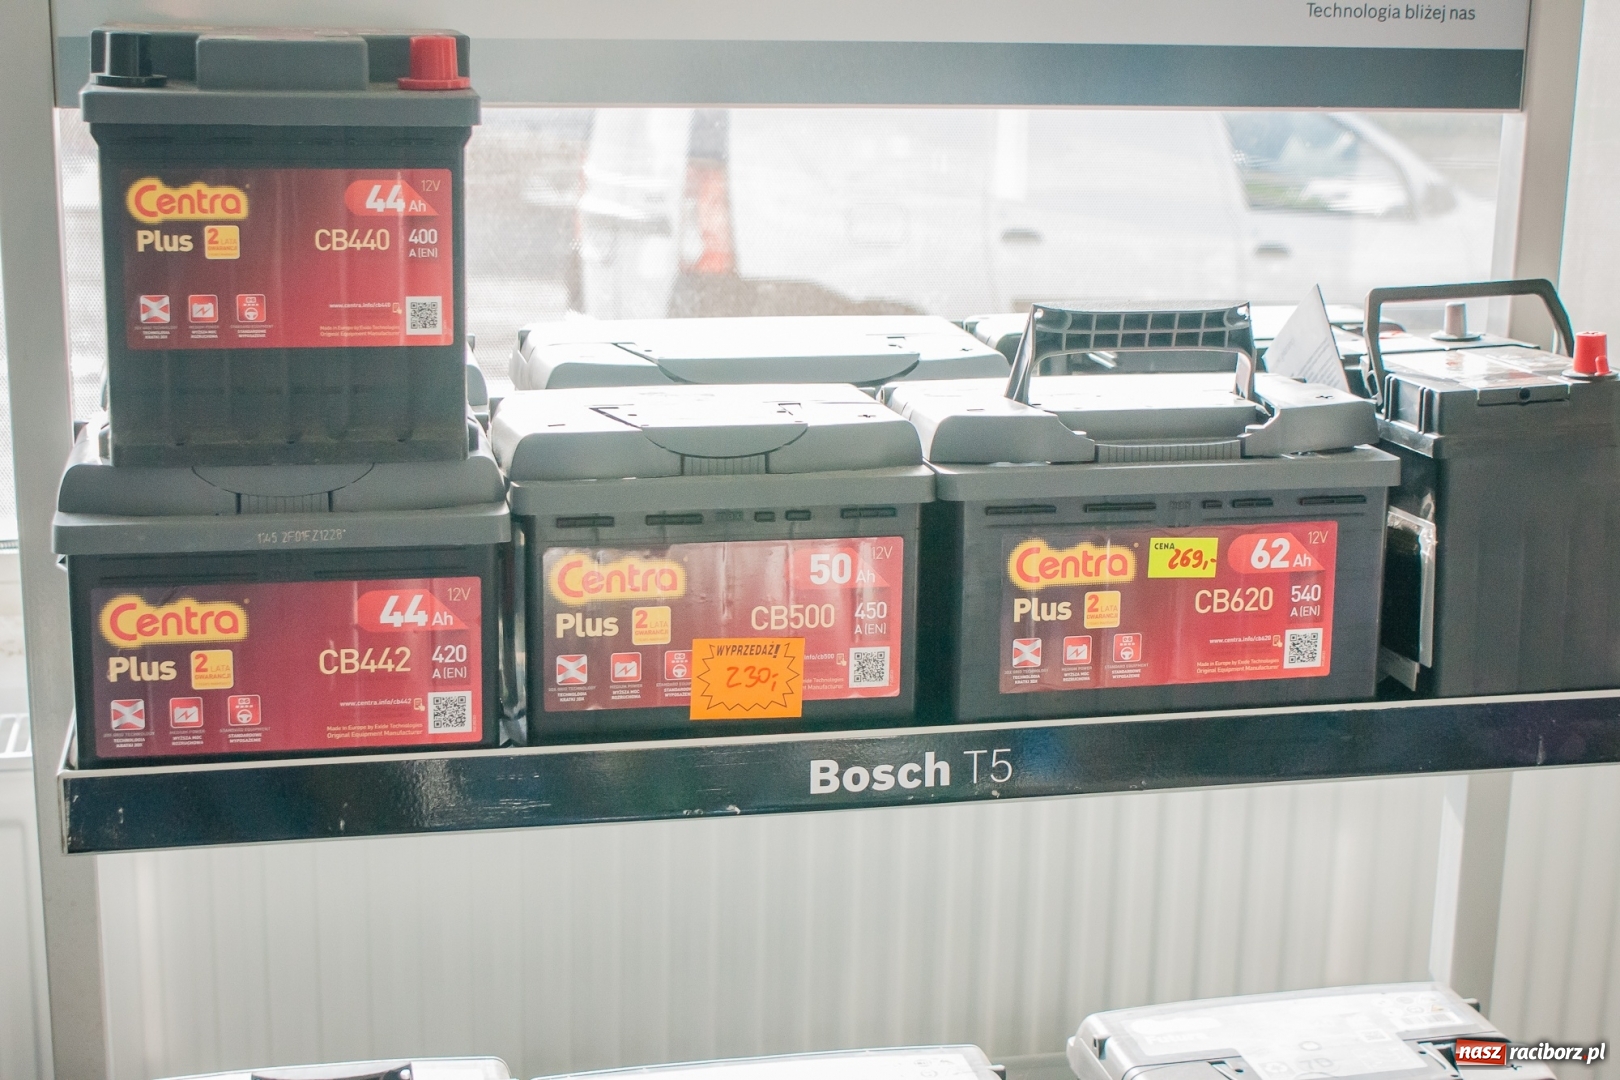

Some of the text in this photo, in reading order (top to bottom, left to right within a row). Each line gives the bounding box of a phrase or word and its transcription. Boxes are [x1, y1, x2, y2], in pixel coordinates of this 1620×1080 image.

[1307, 3, 1475, 23] Technologia bliżej nas
[421, 179, 441, 192] 12V
[134, 184, 242, 217] Centra
[365, 184, 427, 212] 44 Ah
[137, 229, 194, 252] Plus
[207, 228, 219, 245] 2
[314, 228, 390, 251] CB440
[408, 228, 438, 244] 400
[409, 248, 417, 258] A
[1154, 542, 1176, 550] CENA
[1308, 531, 1328, 544] 12V
[872, 546, 893, 560] 12V
[1251, 537, 1312, 569] 62 Ah
[810, 553, 876, 585] 50 Ah
[1016, 547, 1128, 583] Centra
[558, 560, 678, 598] Centra
[447, 587, 471, 602] 12V
[1087, 594, 1118, 613] 2 LATA
[1195, 586, 1273, 614] CB620
[1291, 584, 1321, 603] 540
[380, 594, 453, 627] 44 Ah
[635, 610, 669, 629] 2 LATA
[751, 603, 835, 630] CB500
[854, 602, 887, 620] 450
[1014, 597, 1072, 623] Plus
[1290, 606, 1298, 617] A
[109, 602, 239, 641] Centra
[556, 613, 619, 639] Plus
[854, 624, 862, 635] A
[432, 644, 467, 663] 420
[716, 641, 781, 659] WYPRZEDAŻ!
[108, 656, 178, 683] Plus
[194, 653, 231, 674] 2 LATA
[319, 646, 412, 675] CB442
[432, 669, 442, 679] A
[810, 749, 1013, 794] Bosch T5
